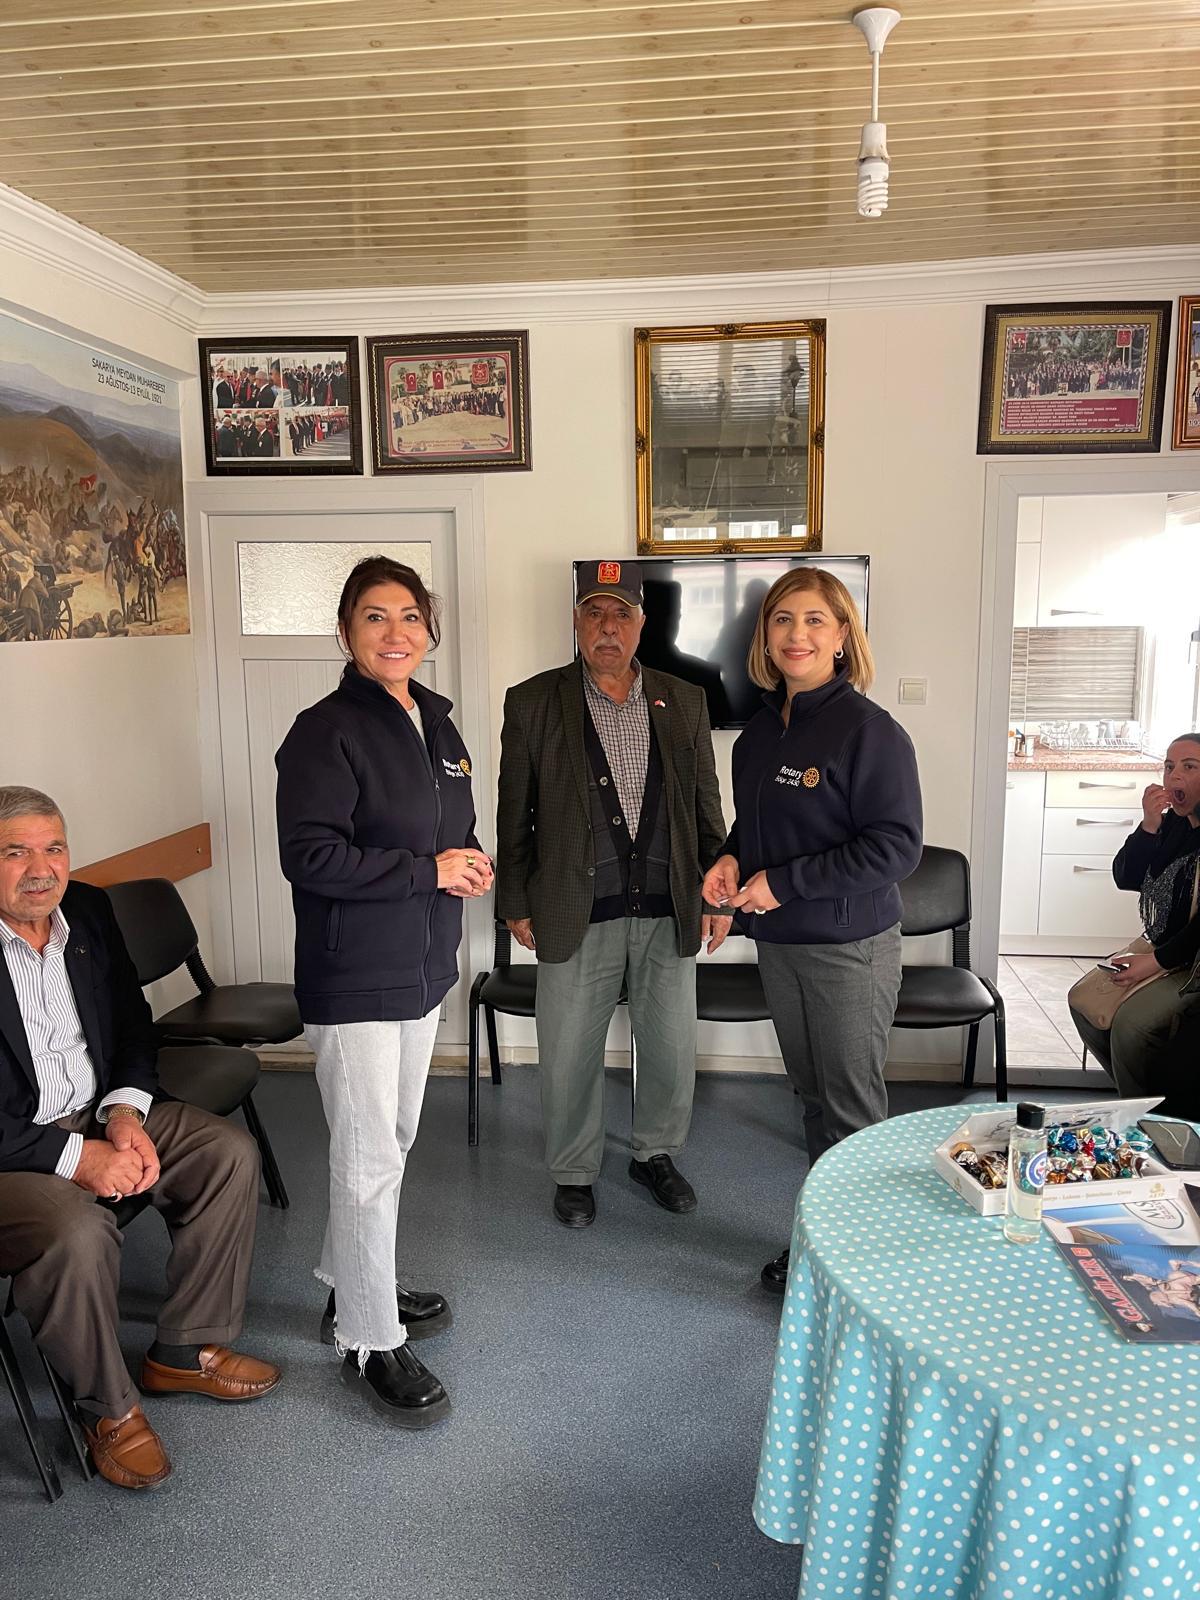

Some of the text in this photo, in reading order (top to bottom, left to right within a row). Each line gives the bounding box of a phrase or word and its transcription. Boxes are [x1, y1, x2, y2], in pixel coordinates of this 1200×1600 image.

[92, 358, 115, 375] SAKARYA
[116, 367, 136, 383] MEYDAN
[97, 373, 104, 384] 23
[106, 375, 136, 395] AĞUSTOS-13
[151, 392, 162, 404] 1921
[779, 765, 803, 780] Rotary
[1078, 1257, 1143, 1321] GAZİLER
